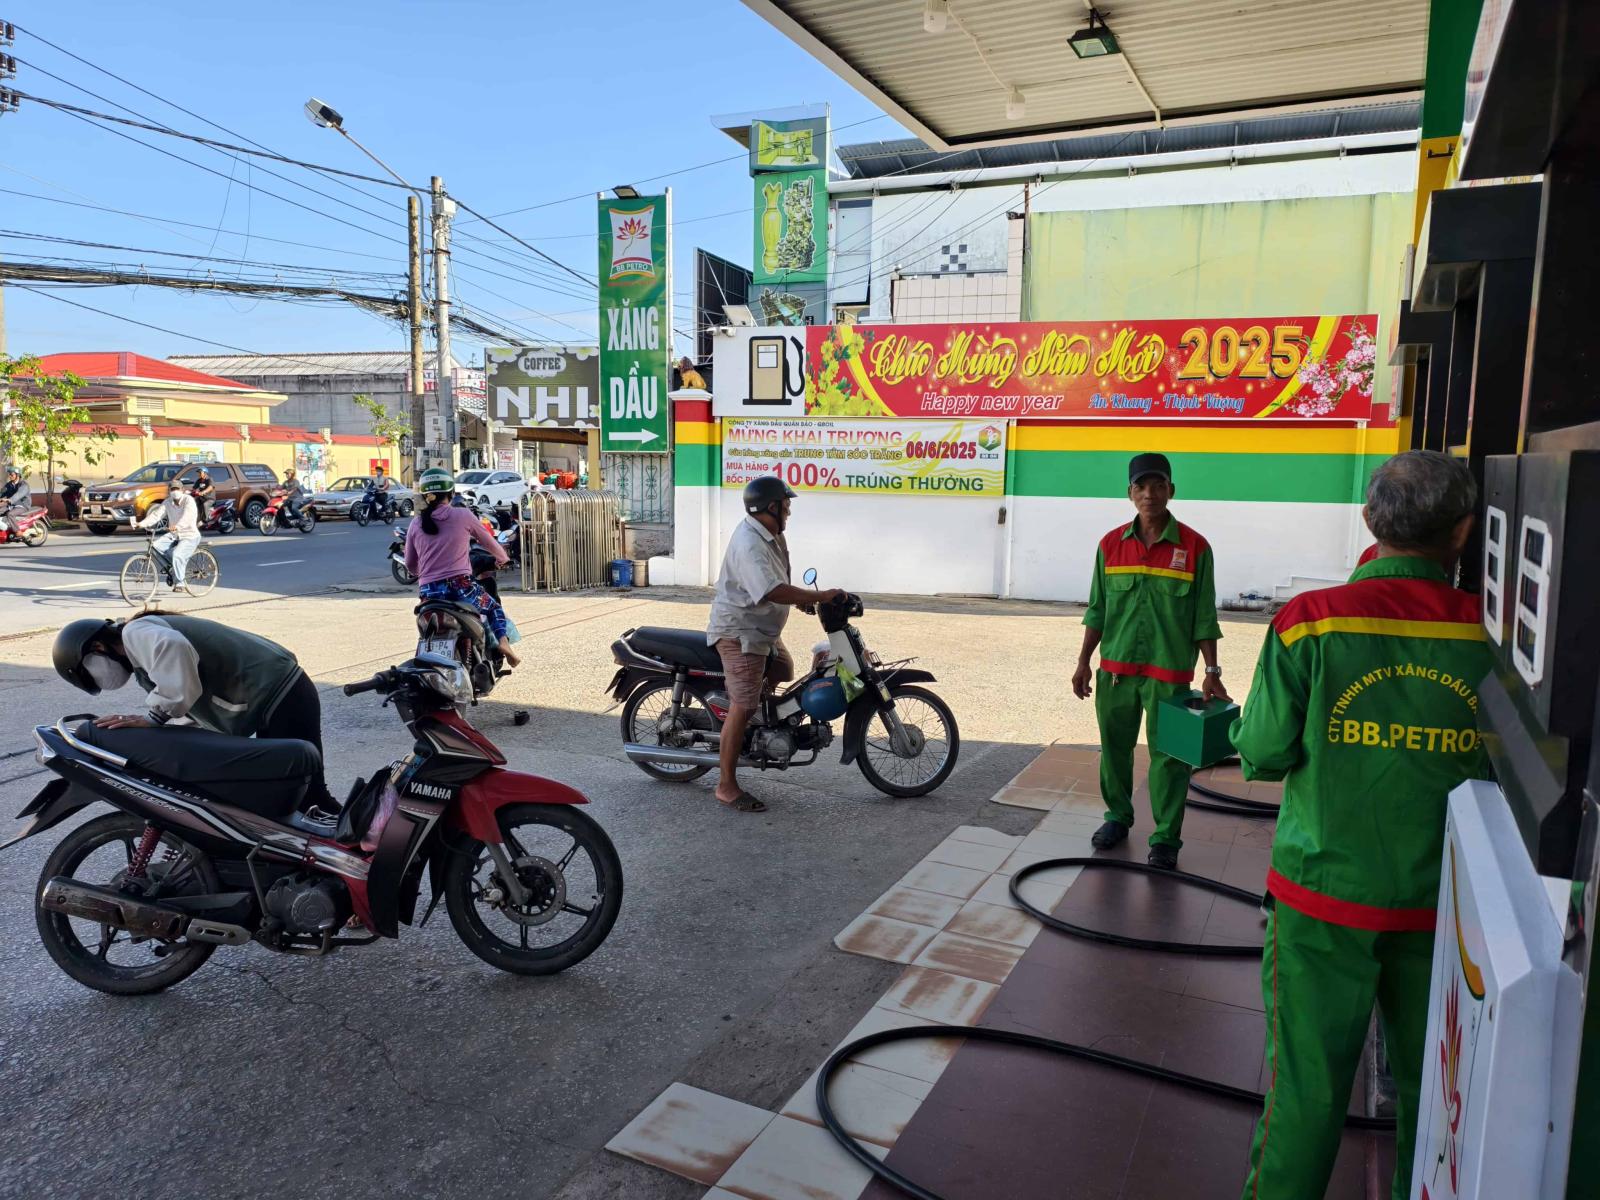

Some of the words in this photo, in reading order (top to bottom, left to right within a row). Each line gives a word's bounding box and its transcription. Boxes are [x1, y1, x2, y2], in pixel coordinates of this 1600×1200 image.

[616, 264, 625, 272] BB
[607, 298, 659, 351] XĂNG
[524, 357, 561, 370] COFFEE
[870, 334, 934, 385] Chúc
[935, 330, 1019, 388] Mừng
[1094, 328, 1165, 383] Mới
[1178, 326, 1303, 380] 2025
[609, 361, 658, 419] DẦU
[496, 387, 589, 421] NHI
[920, 392, 979, 414] Happy
[981, 395, 1019, 411] new
[1021, 395, 1064, 414] year
[1088, 393, 1107, 409] An
[1110, 392, 1153, 413] Khang
[1202, 393, 1245, 414] Vượng
[728, 425, 778, 443] MỪNG
[782, 429, 822, 444] KHAI
[827, 430, 902, 446] TRƯƠNG
[793, 448, 825, 459] TRUNG
[826, 447, 846, 459] TÂM
[905, 441, 977, 459] 06/6/2025
[726, 462, 743, 470] MUA
[745, 460, 769, 471] HÀNG
[772, 462, 840, 488] 100%
[845, 472, 902, 489] TRÚNG
[907, 474, 984, 491] THƯỞNG
[726, 473, 743, 484] BỐC
[1362, 666, 1392, 687] MTV
[1333, 681, 1364, 716] TNHH
[1328, 717, 1342, 743] CTY
[1343, 720, 1476, 753] BB.PETRO
[410, 782, 451, 800] YAMAHA
